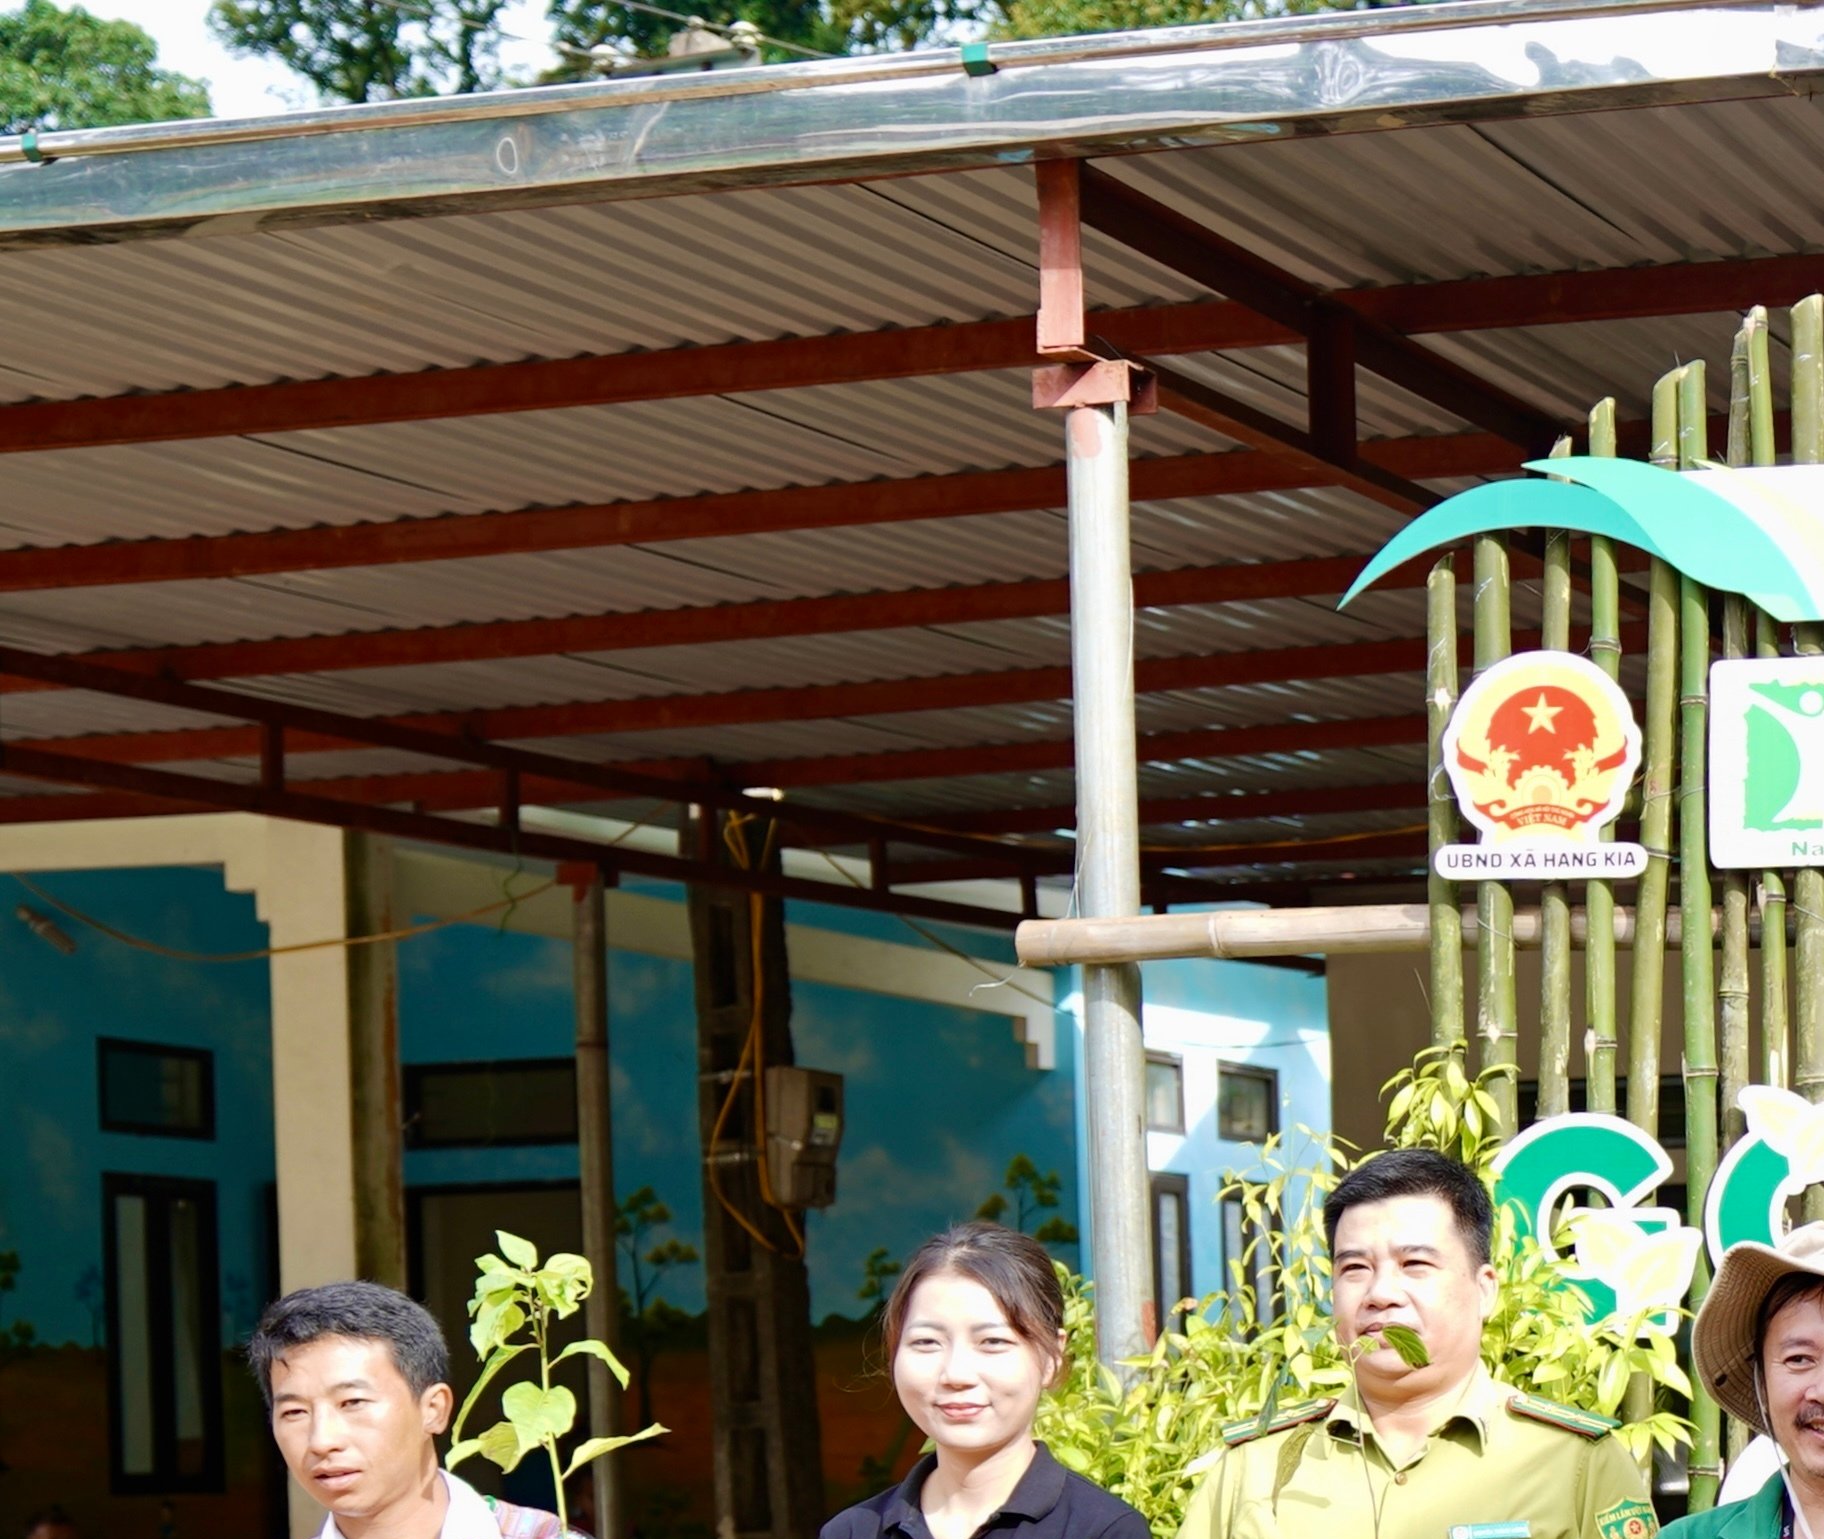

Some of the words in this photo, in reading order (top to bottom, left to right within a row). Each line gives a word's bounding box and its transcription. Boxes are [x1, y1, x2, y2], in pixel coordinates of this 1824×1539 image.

[1447, 853, 1502, 868] UBND
[1544, 852, 1597, 867] HANG
[1604, 851, 1636, 866] KIA
